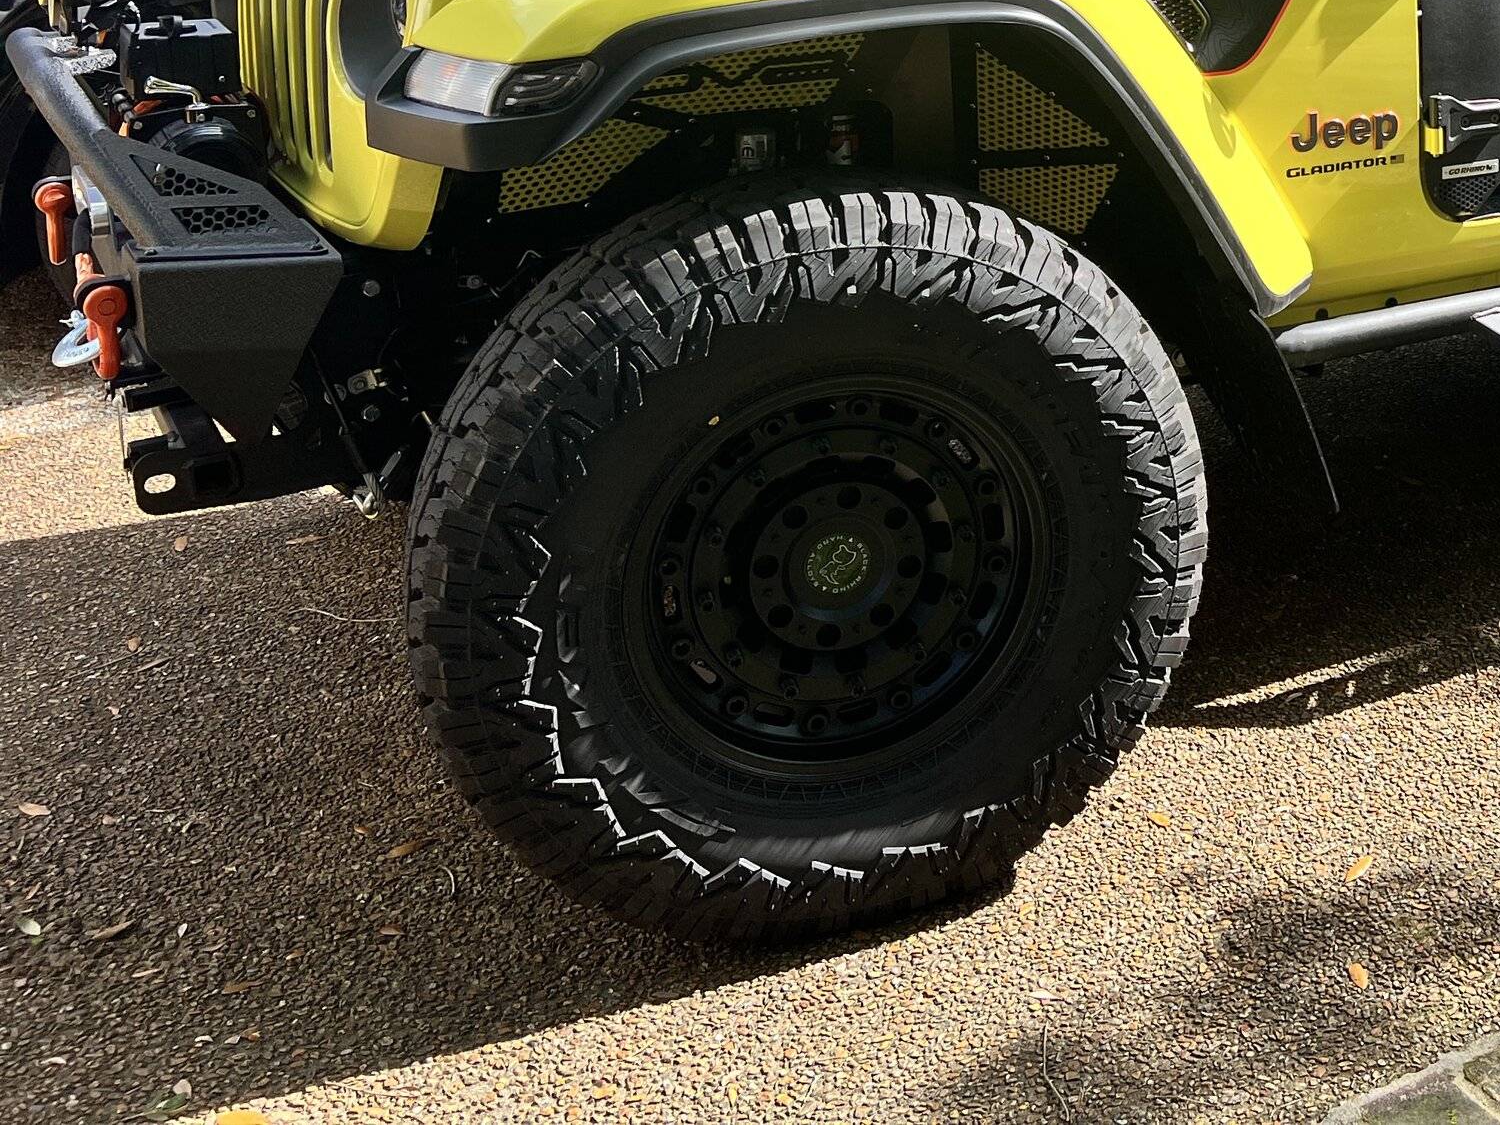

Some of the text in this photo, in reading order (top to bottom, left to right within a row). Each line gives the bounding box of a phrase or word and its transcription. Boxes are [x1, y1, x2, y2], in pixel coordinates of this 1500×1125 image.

[1289, 110, 1399, 153] Jeep
[1286, 156, 1388, 178] GLADIATOR
[1448, 165, 1486, 176] GO RHINO
[832, 542, 869, 594] BLACK RHINO
